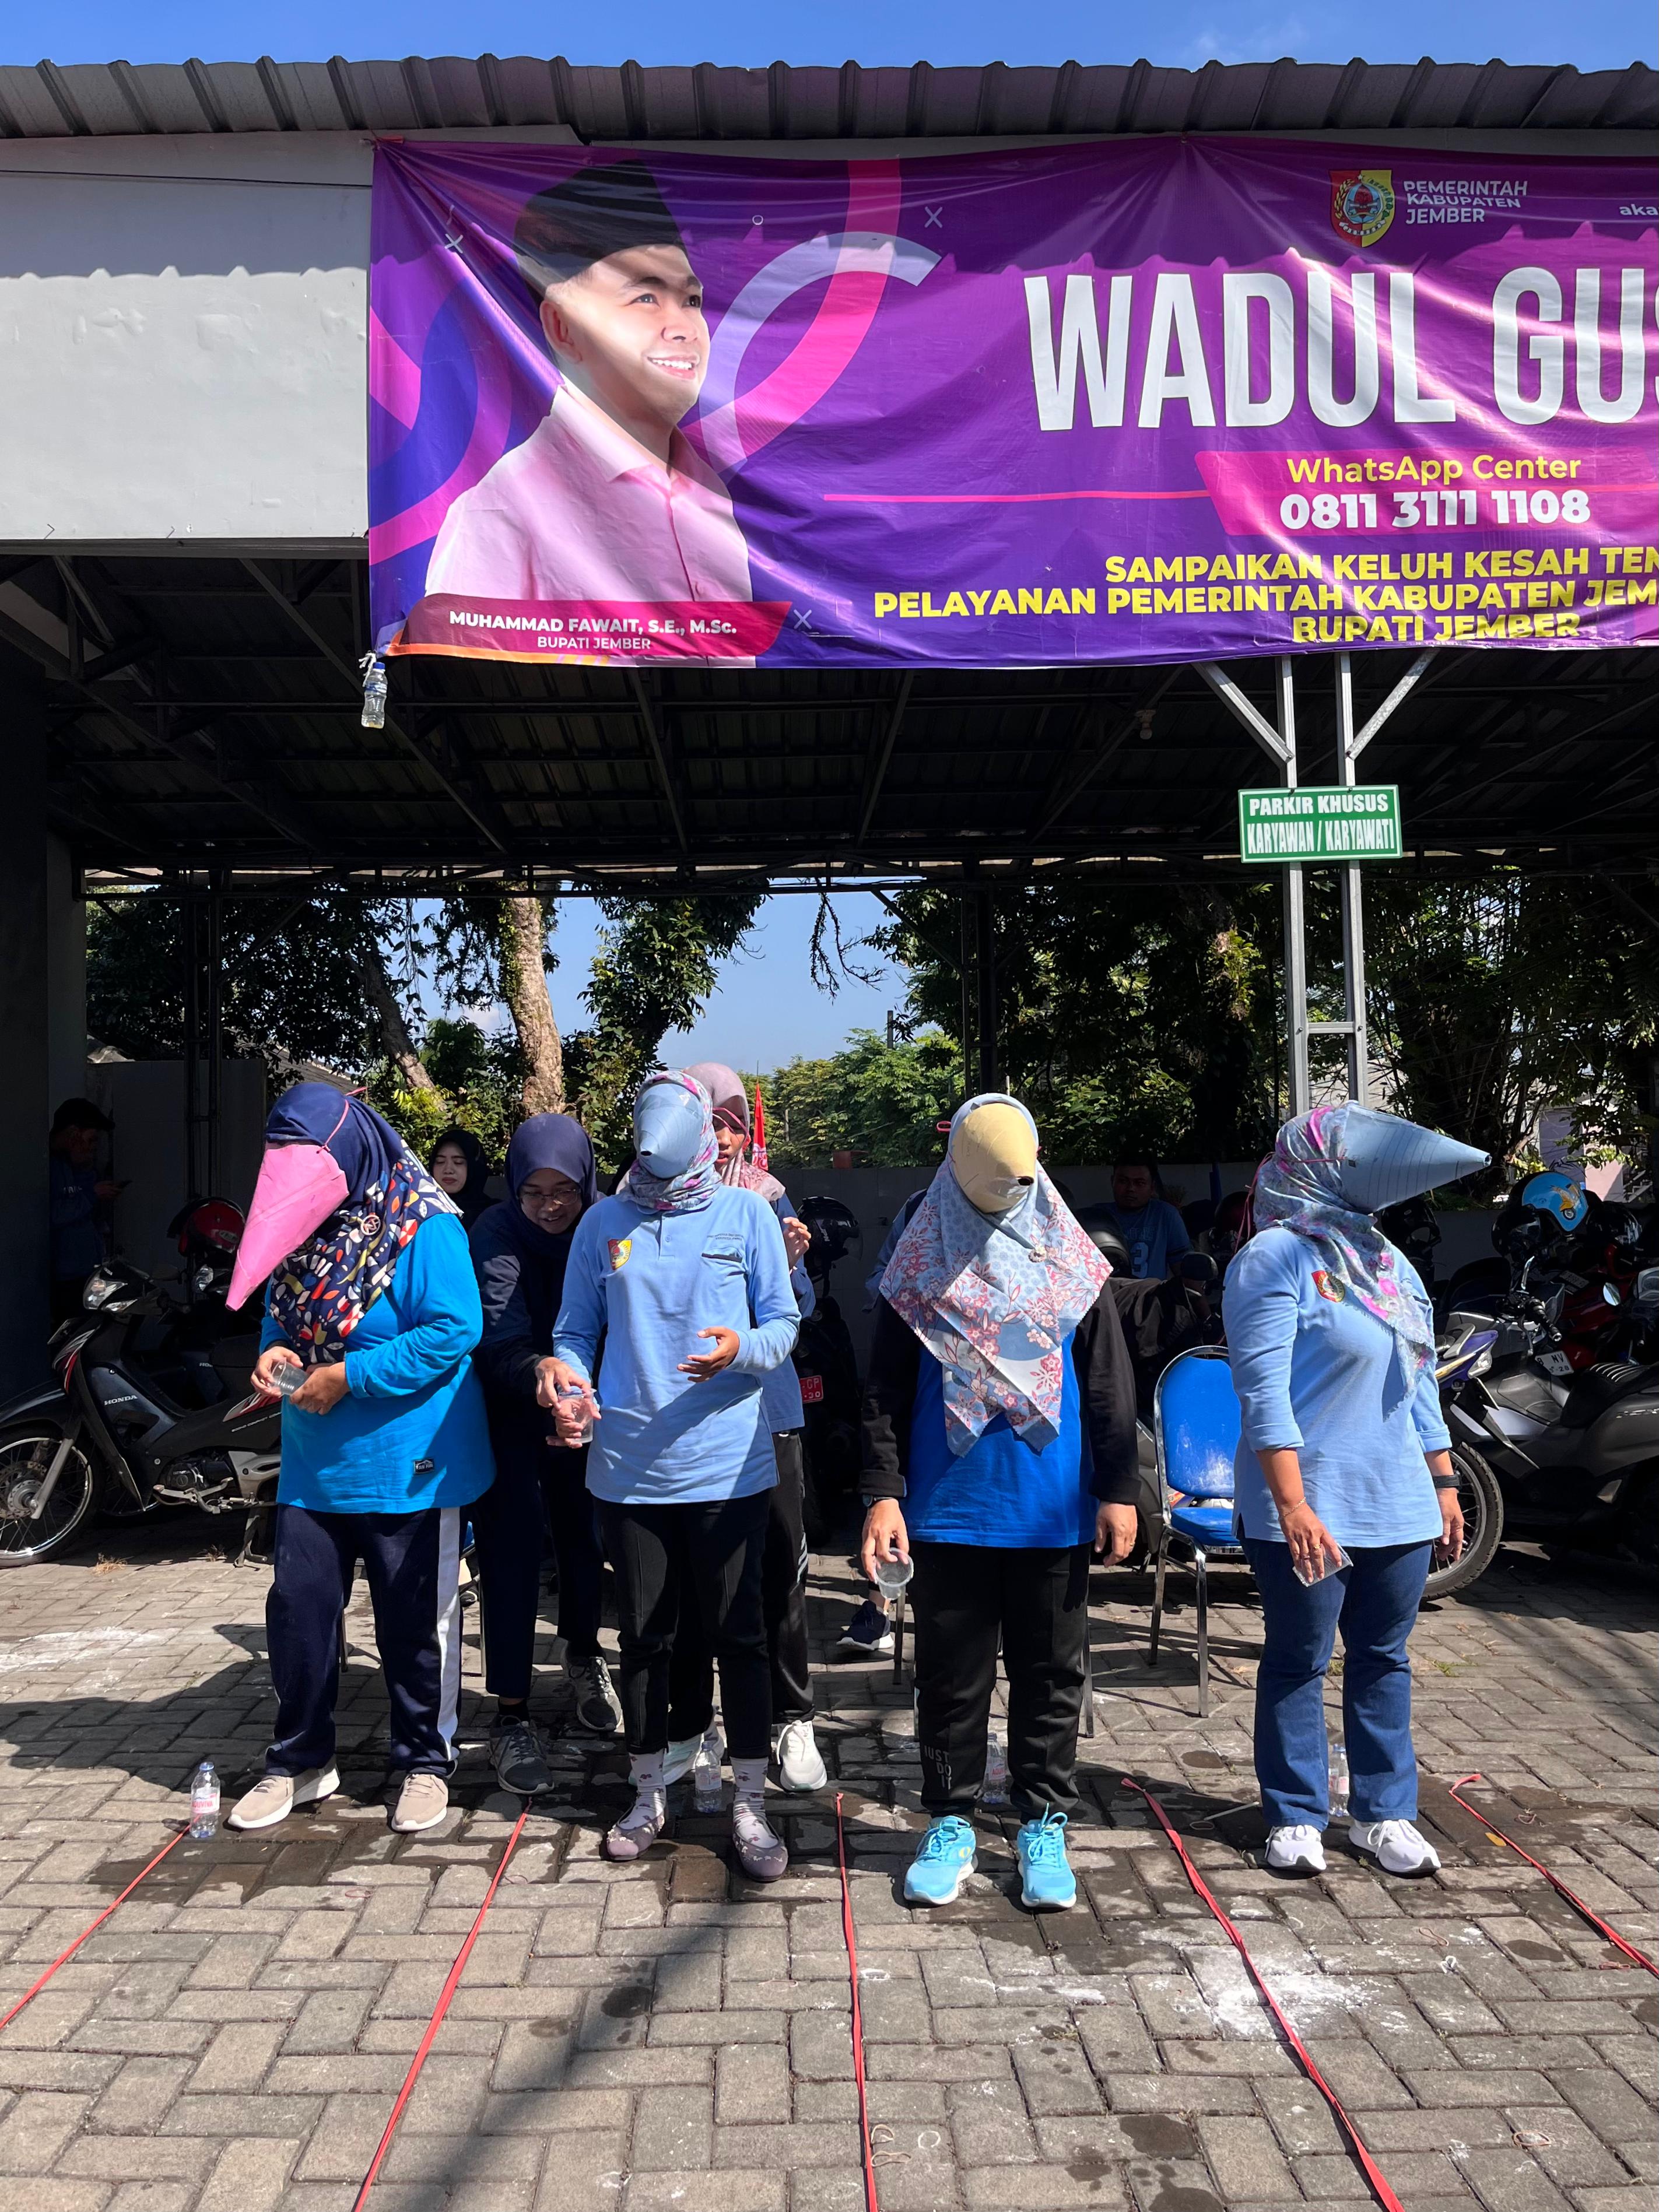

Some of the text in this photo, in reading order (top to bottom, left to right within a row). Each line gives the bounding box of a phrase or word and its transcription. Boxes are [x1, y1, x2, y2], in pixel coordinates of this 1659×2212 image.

[1403, 180, 1528, 196] PEMERINTAH
[1407, 193, 1521, 208] KABUPATEN
[1619, 203, 1659, 215] aka
[1405, 208, 1485, 224] JEMBER
[1023, 266, 1659, 431] WADUL GU
[1286, 455, 1581, 486] WhatsApp Center
[1280, 489, 1591, 529] 0811 3111 1108
[1105, 553, 1324, 583] SAMPAIKAN
[1333, 552, 1451, 581] KELUH
[1465, 547, 1589, 578] KESAH
[875, 579, 1657, 618] PELAYANAN PEMERINTAH KABUPATEN JEM
[450, 610, 737, 635] MUHAMMAD FAWAIT, S.E., M.Sc.
[1292, 612, 1580, 644] BUPATI JEMBER
[537, 636, 651, 650] BUPATI JEMBER
[1249, 793, 1389, 816] PARKIR KHUSUS
[1247, 821, 1314, 854] KARYAWAN
[1324, 818, 1394, 851] KARYAWATI
[104, 1395, 138, 1406] HONDA
[937, 1762, 952, 1777] DO
[941, 1774, 952, 1790] IT
